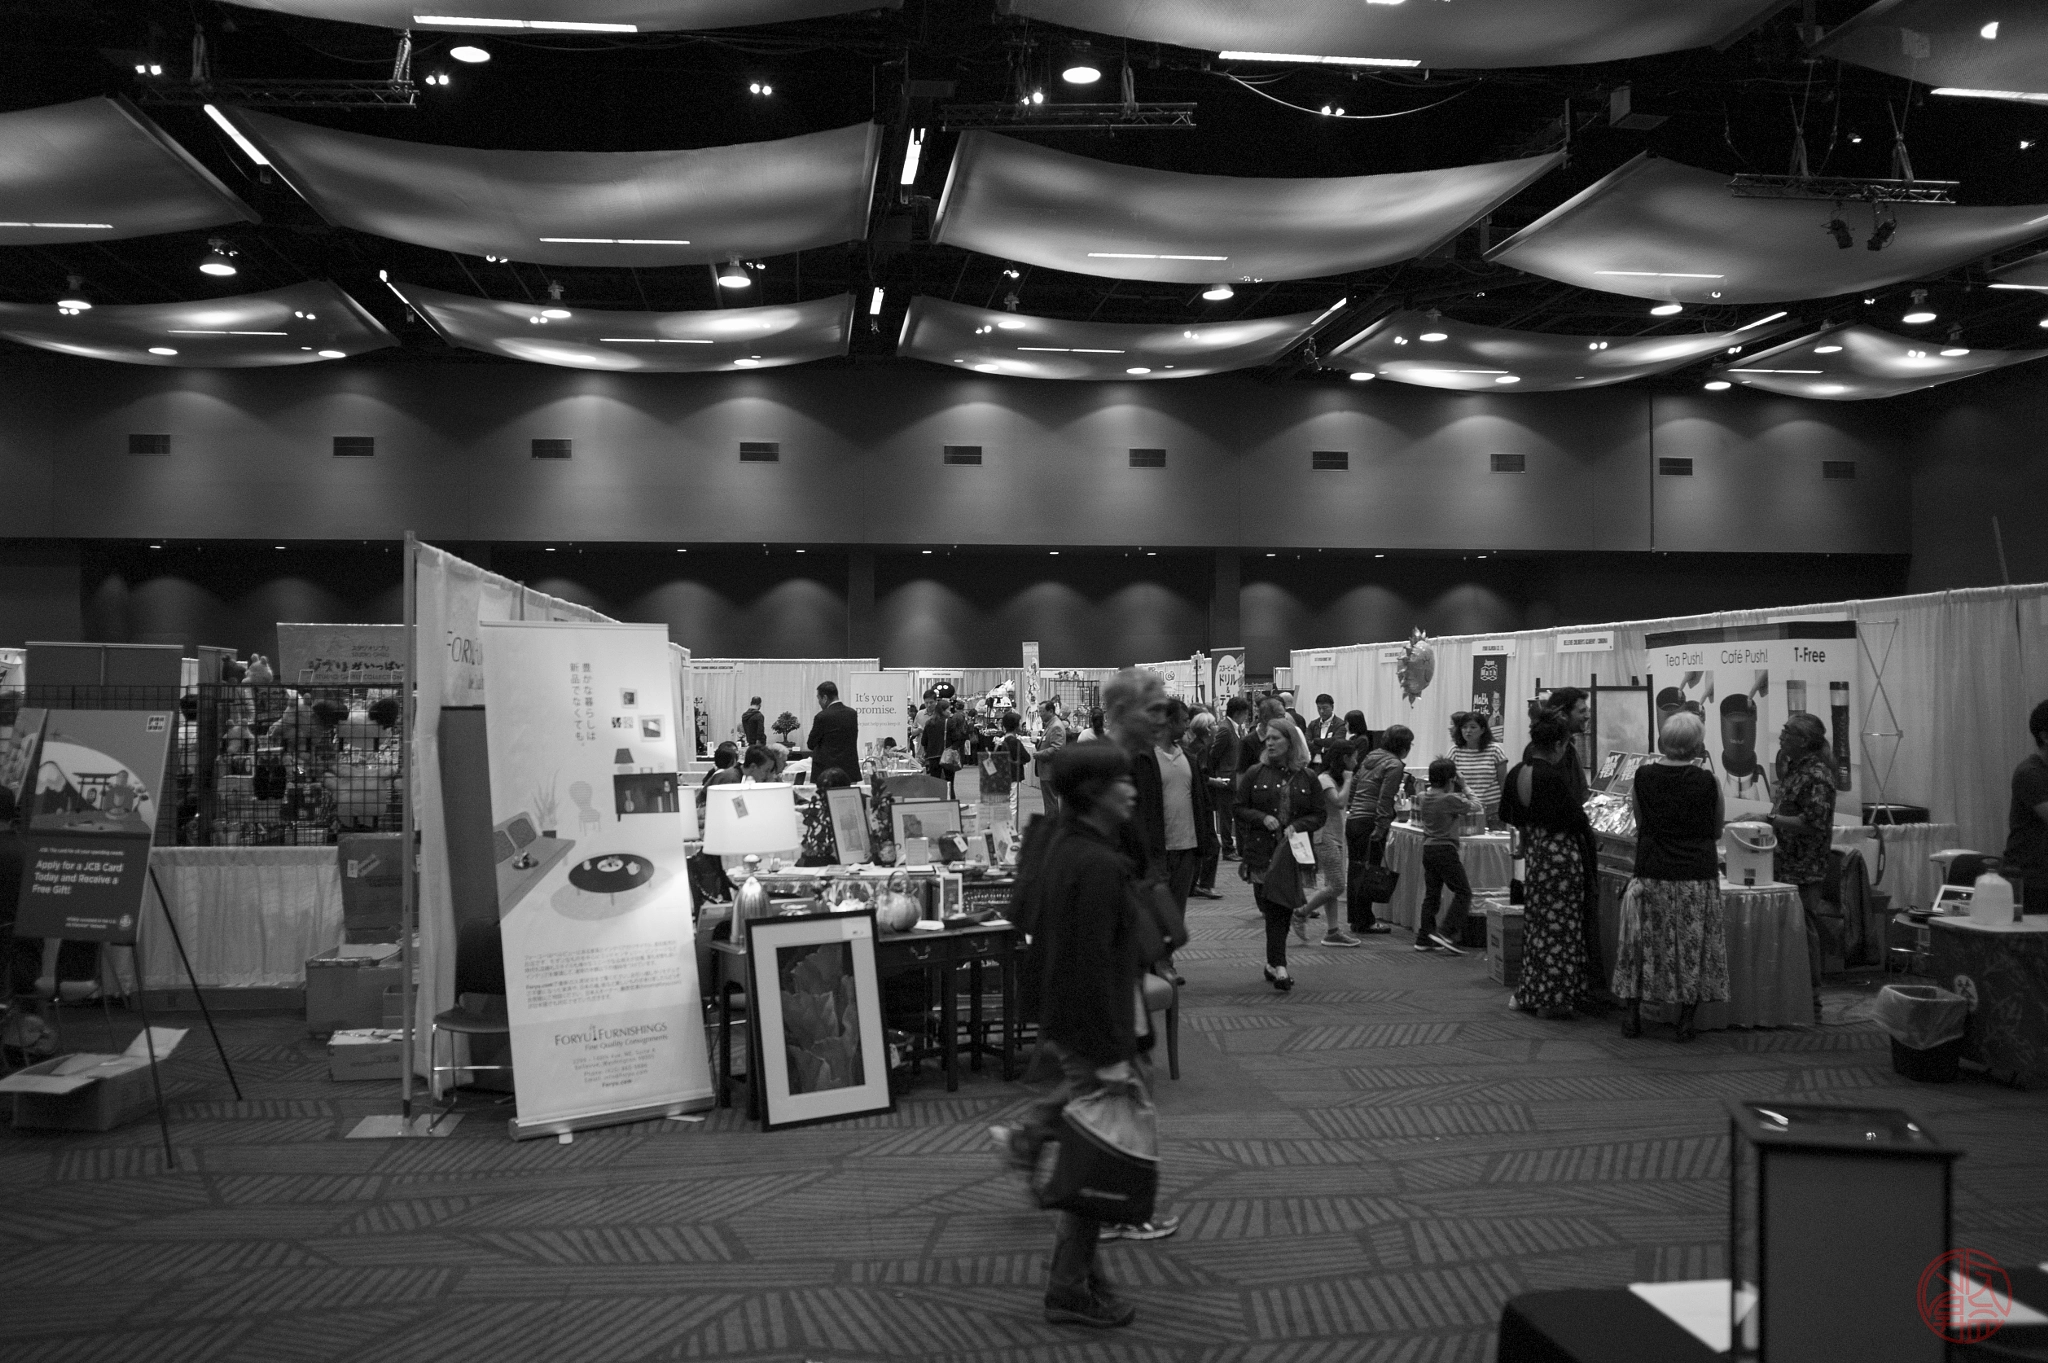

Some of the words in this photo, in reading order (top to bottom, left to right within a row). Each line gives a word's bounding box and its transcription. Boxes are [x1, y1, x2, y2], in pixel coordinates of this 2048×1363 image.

[1665, 653, 1680, 667] Tea
[1682, 651, 1704, 665] Push!
[1720, 648, 1743, 665] Café
[1745, 648, 1768, 663] Push!
[1794, 646, 1826, 663] T-Free
[1219, 674, 1237, 686] ドリル
[856, 692, 870, 702] It's
[871, 695, 894, 705] your
[856, 704, 897, 714] promise.
[35, 860, 60, 871] Apply
[62, 861, 75, 870] for
[83, 863, 101, 871] JCB
[102, 863, 123, 872] Card
[34, 872, 59, 883] Today
[60, 874, 76, 882] and
[78, 874, 110, 884] Receive
[32, 884, 51, 893] Free
[52, 885, 71, 894] Gift!
[554, 1032, 592, 1046] FORYU
[598, 1022, 668, 1040] FURNISHINGS
[600, 1040, 623, 1050] Quality
[625, 1034, 669, 1045] Consignments
